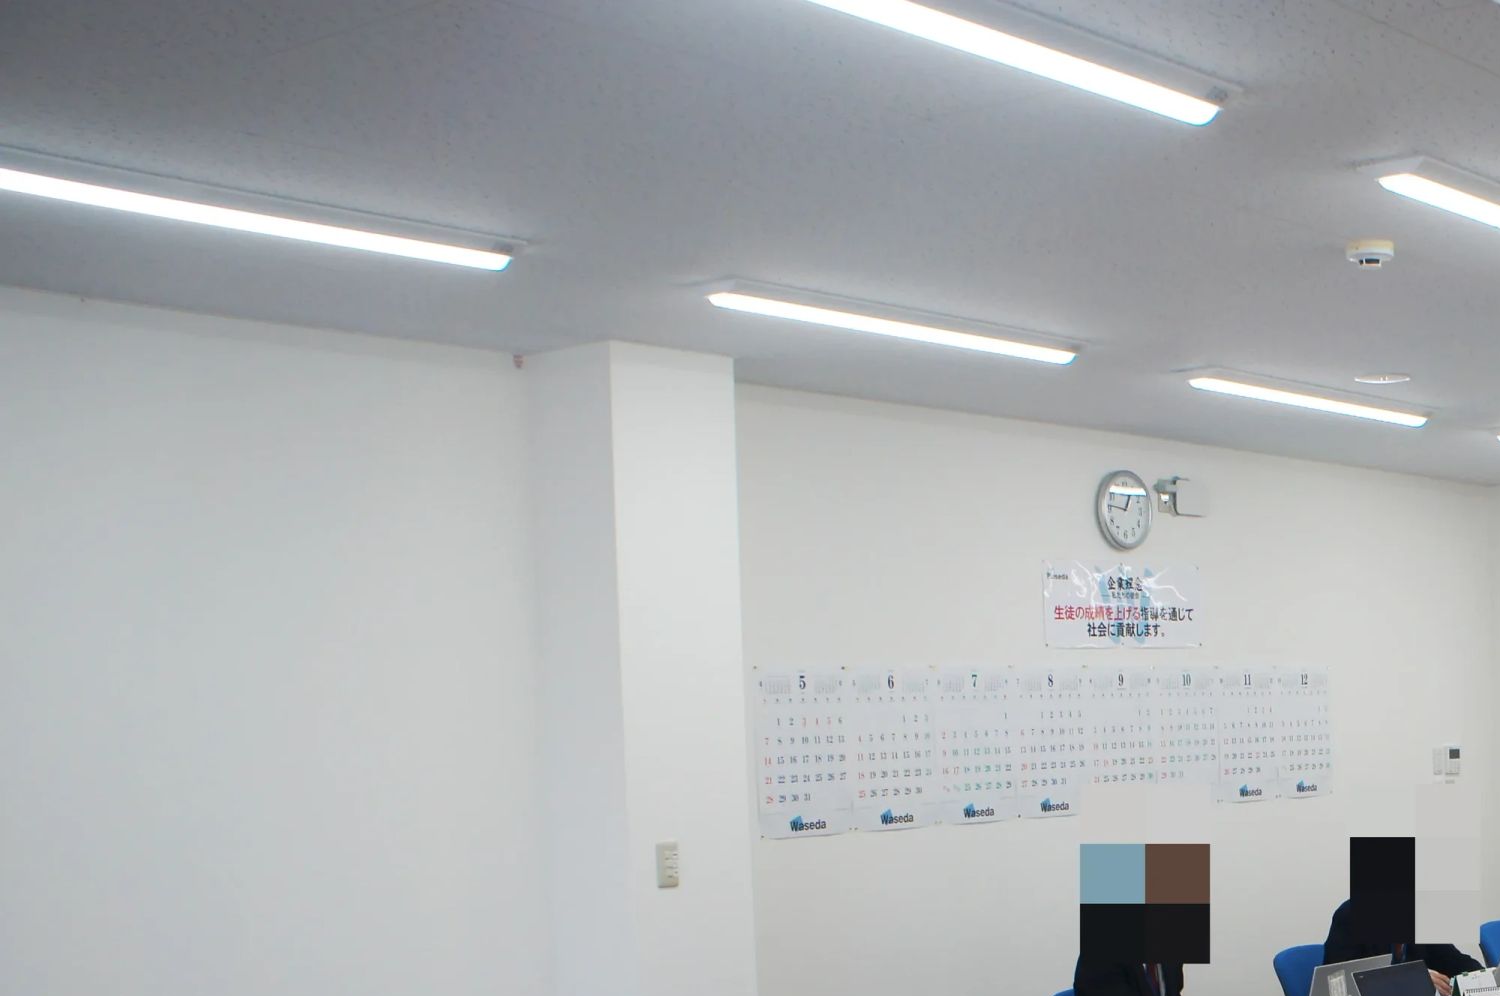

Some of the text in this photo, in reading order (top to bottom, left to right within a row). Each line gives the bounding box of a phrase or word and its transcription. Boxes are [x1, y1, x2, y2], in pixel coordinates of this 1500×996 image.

[1087, 622, 1165, 638] 社会に貢献します。
[799, 675, 806, 690] 5
[887, 675, 895, 689] 6
[971, 674, 978, 688] 7
[1047, 673, 1054, 687] 8
[1118, 673, 1124, 686] 9
[1182, 673, 1191, 686] 10
[1244, 674, 1251, 685] 11
[1301, 673, 1308, 685] 12
[963, 806, 995, 819] Waseda
[1040, 801, 1070, 813] Waseda
[881, 812, 914, 825] Waseda
[790, 819, 827, 832] Waseda
